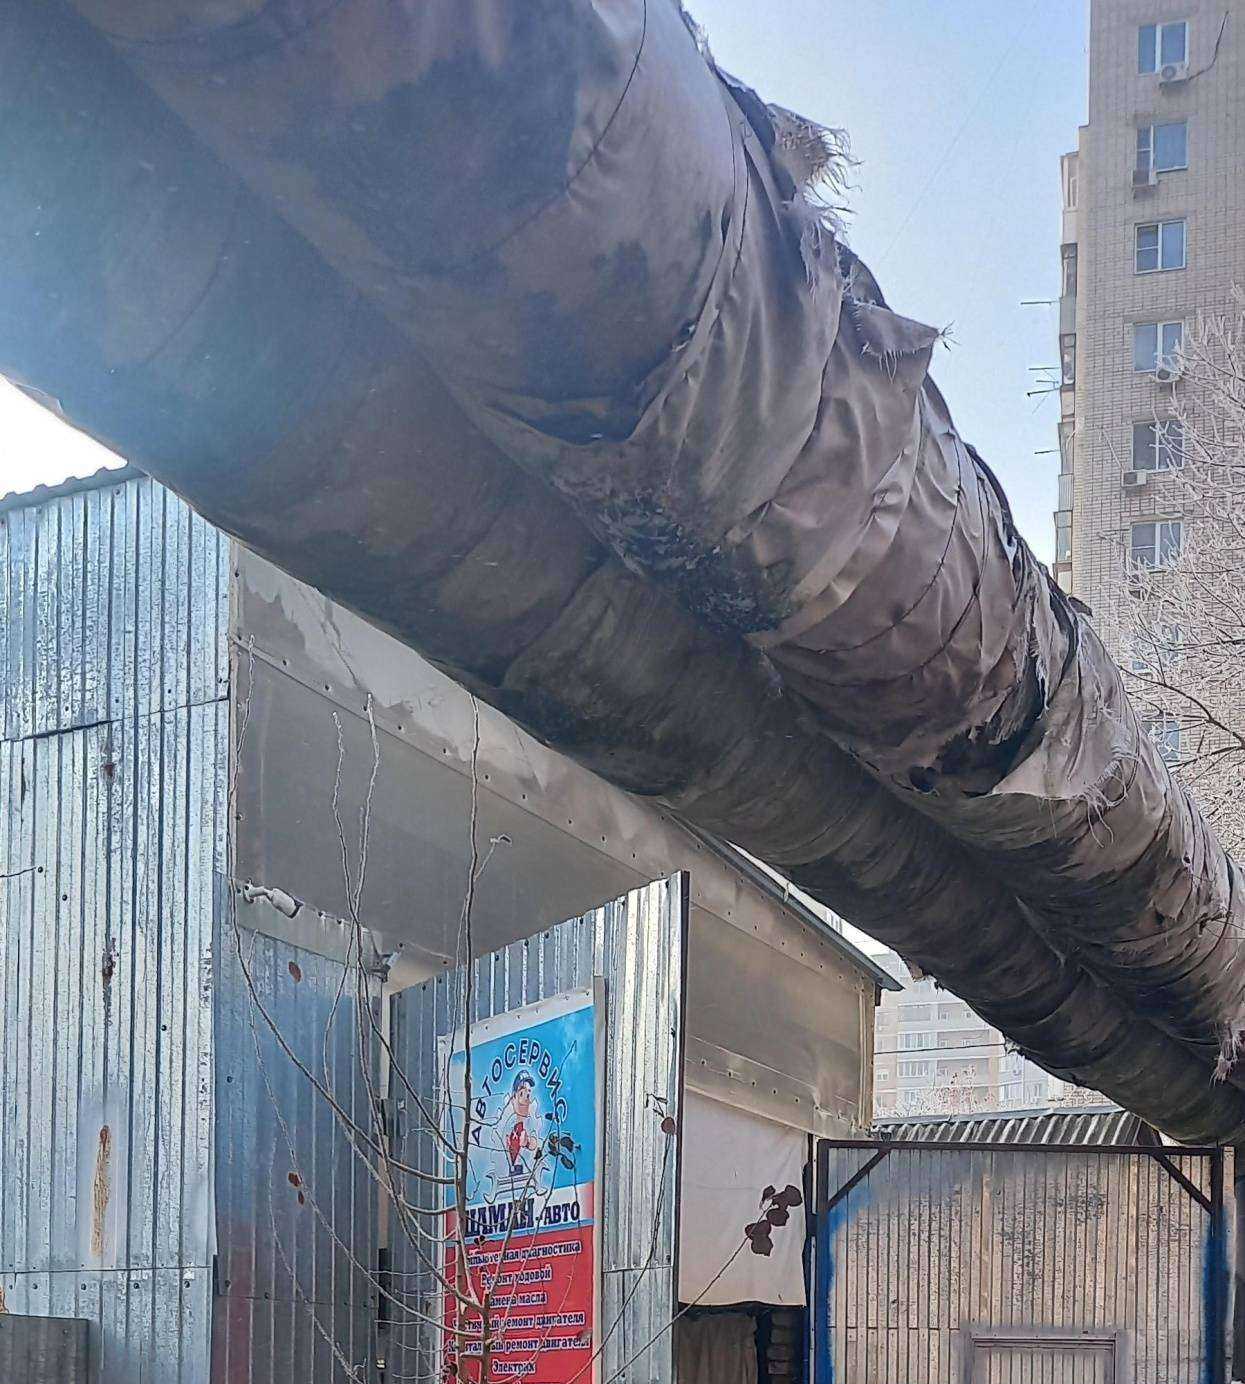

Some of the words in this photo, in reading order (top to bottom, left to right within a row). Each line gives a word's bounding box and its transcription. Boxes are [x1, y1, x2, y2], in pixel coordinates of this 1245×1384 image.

[470, 1038, 568, 1148] АВТОСЕРВИС
[490, 1294, 517, 1307] амена
[505, 1339, 538, 1353] ремонт
